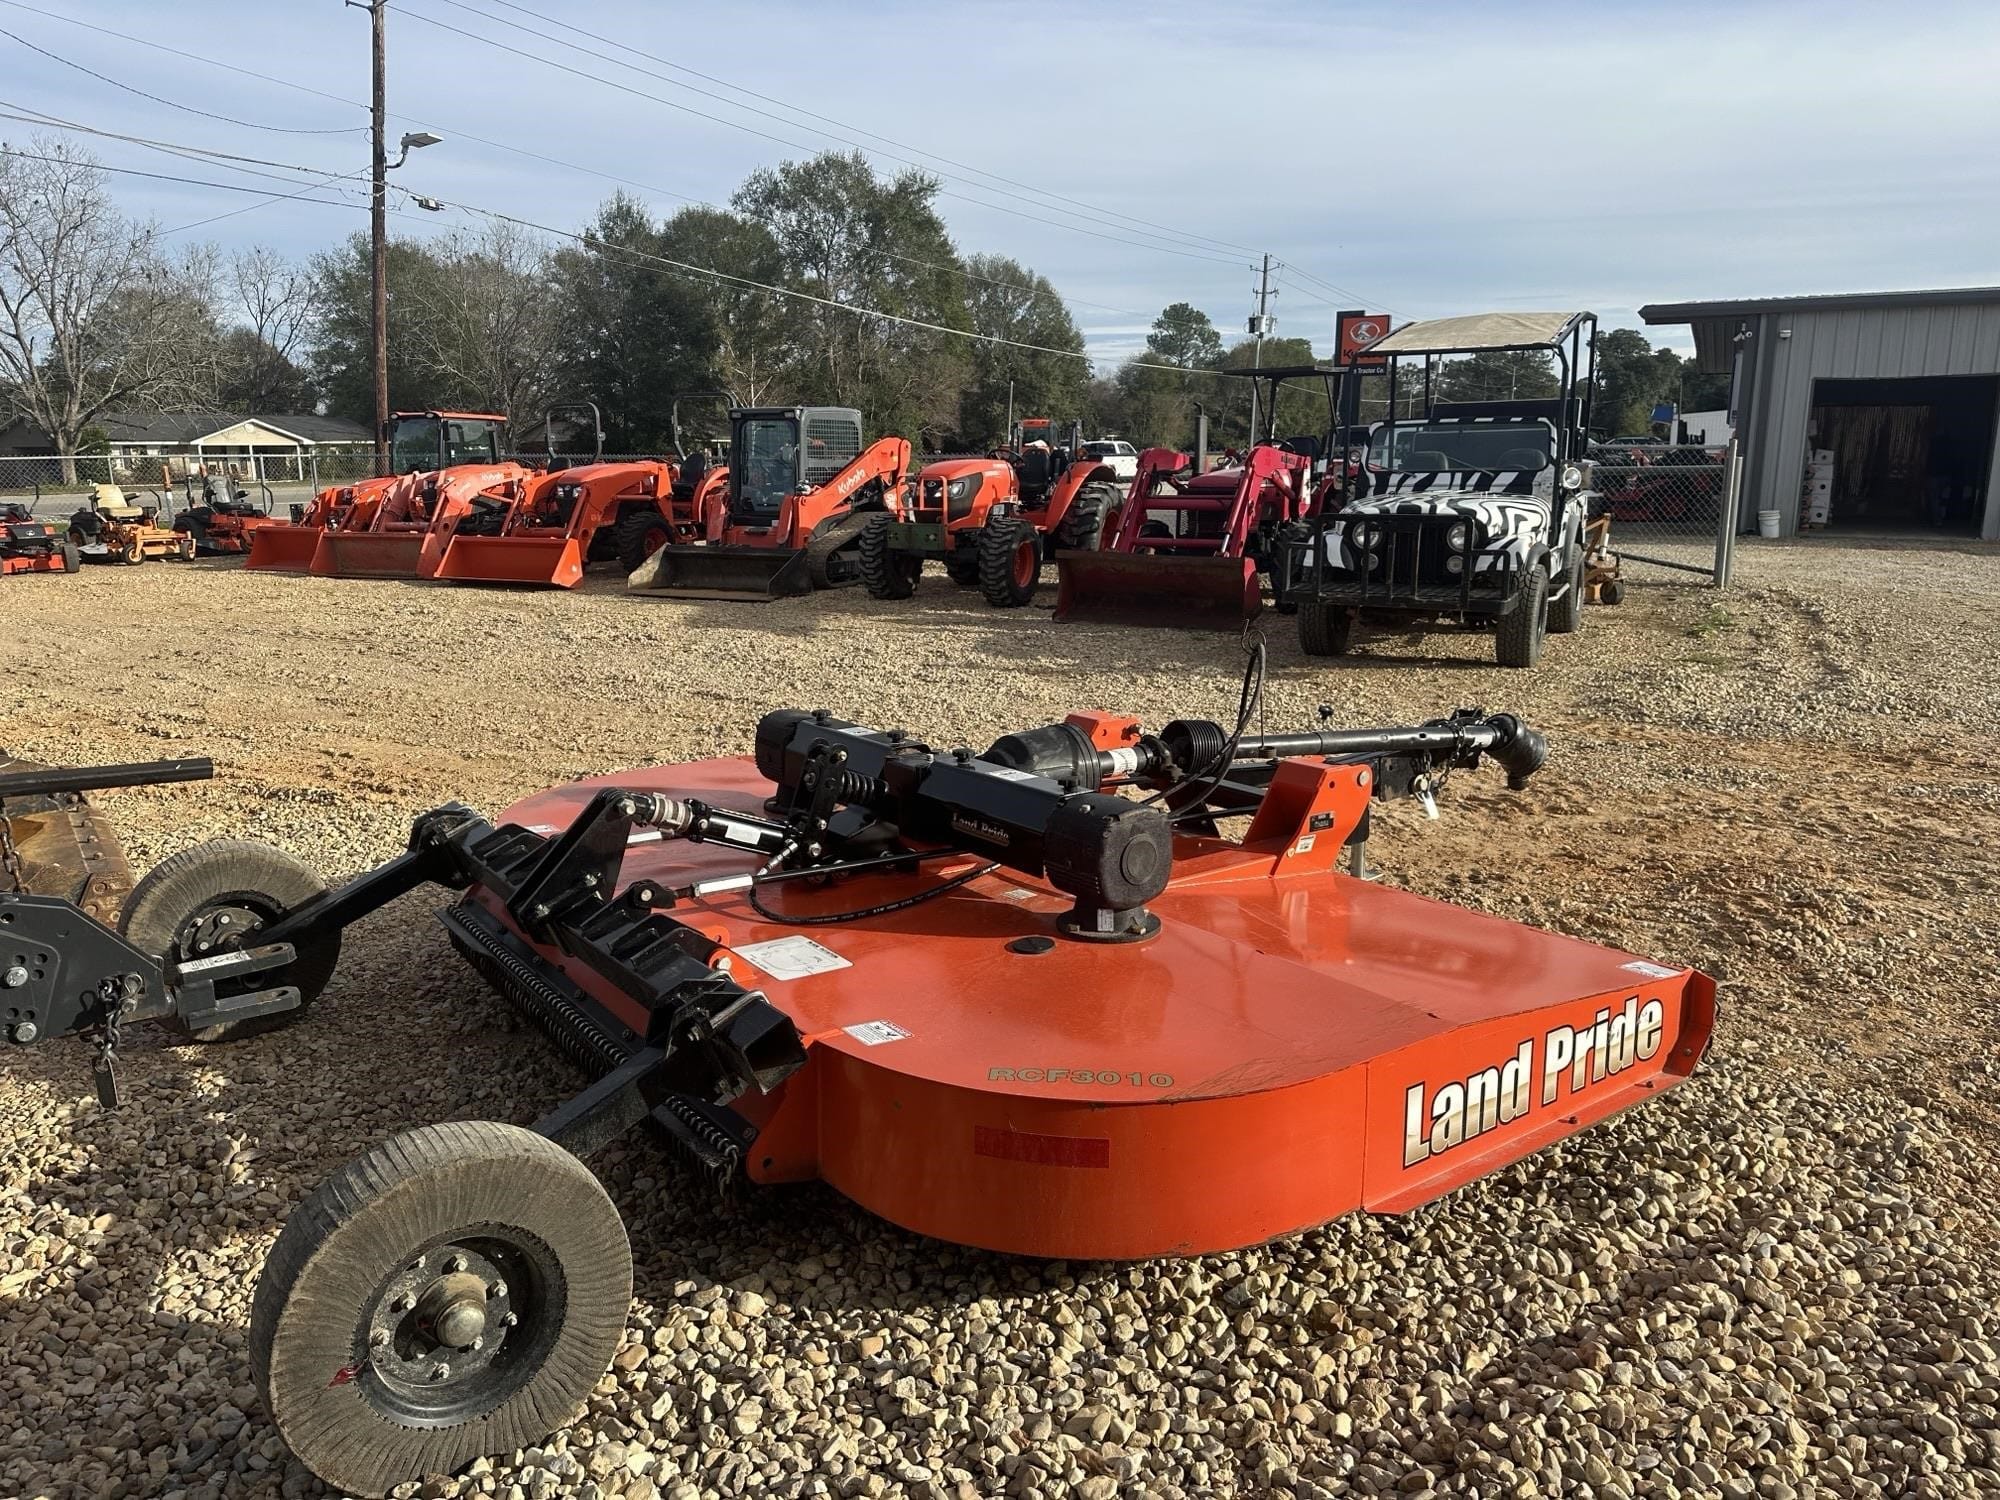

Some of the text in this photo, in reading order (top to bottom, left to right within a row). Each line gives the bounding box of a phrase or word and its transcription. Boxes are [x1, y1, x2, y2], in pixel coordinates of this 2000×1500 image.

[837, 468, 866, 495] Kubota
[987, 1067, 1175, 1088] RCF3010
[1403, 994, 1664, 1169] Land Pride
